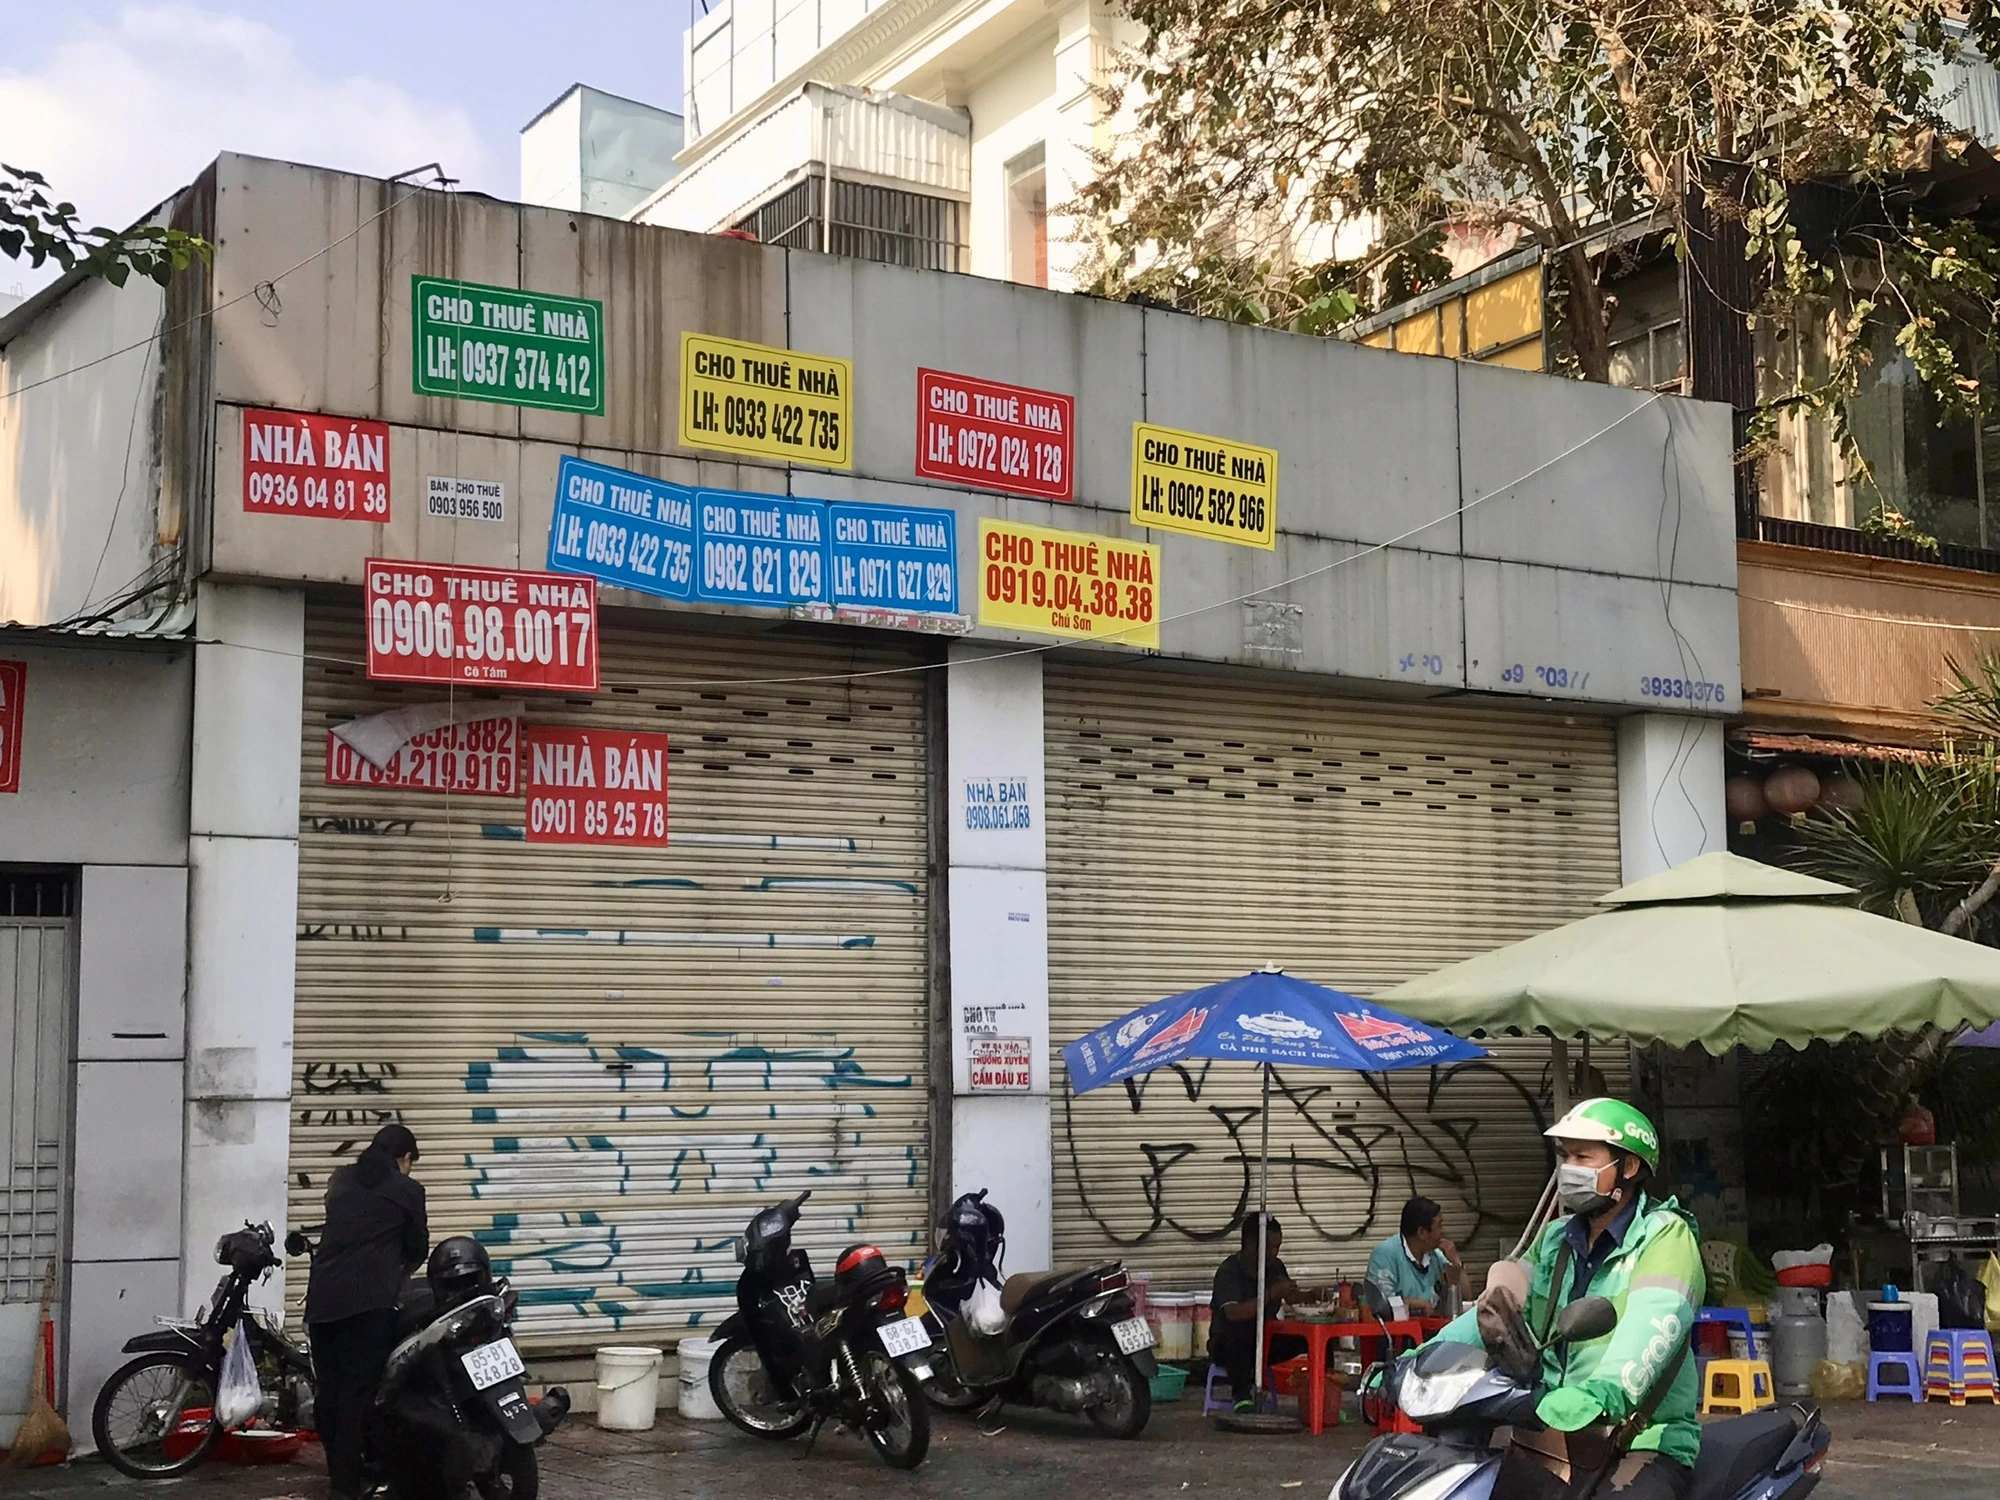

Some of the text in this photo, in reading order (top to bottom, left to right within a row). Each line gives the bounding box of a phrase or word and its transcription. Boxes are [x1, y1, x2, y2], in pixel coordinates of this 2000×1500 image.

[427, 294, 590, 340] CHO THUÊ NHÀ
[427, 335, 590, 397] LH: 0937 374 412
[694, 350, 839, 397] CHO THUÊ NHÀ
[693, 390, 839, 451] LH: 0933 422 735
[930, 386, 1063, 431] CHO THUÊ NHÀ
[249, 419, 385, 473] NHÀ BÁN
[928, 422, 1062, 484] LH: 0972 024 128
[1144, 439, 1266, 484] CHO THUÊ NHÀ
[249, 472, 387, 514] 0936 04 81 38
[429, 495, 502, 519] 0903 956 500
[430, 479, 449, 492] BÁN
[456, 482, 474, 494] CHO
[477, 484, 500, 497] THUÊ
[568, 475, 692, 528] CHO THUÊ NHÀ
[1142, 474, 1265, 533] LH: 0902 582 966
[703, 504, 821, 542] CHO THUÊ NHÀ
[835, 517, 947, 549] CHO THUÊ NHÀ
[556, 513, 692, 584] LH: 0933 422 735
[704, 541, 821, 598] 0982 821 829
[986, 531, 1153, 585] CHO THUÊ NHÀ
[371, 571, 590, 609] CHO THUÊ NHÀ
[833, 555, 951, 602] LH: 0971 627 929
[986, 563, 1153, 623] 0919.04.38.38
[372, 598, 591, 667] 0906.98.0017
[1051, 611, 1070, 629] Chú
[464, 665, 507, 679] Cô Tám
[1640, 676, 1725, 703] 39330376
[532, 735, 662, 791] NHÀ BÁN
[966, 777, 1026, 803] NHÀ BÁN
[531, 797, 665, 838] 0901 85 25 78
[966, 804, 1030, 829] 0908.061.068
[1016, 1072, 1029, 1085] XE
[1623, 1121, 1657, 1150] Grab
[1621, 1313, 1681, 1396] Grab
